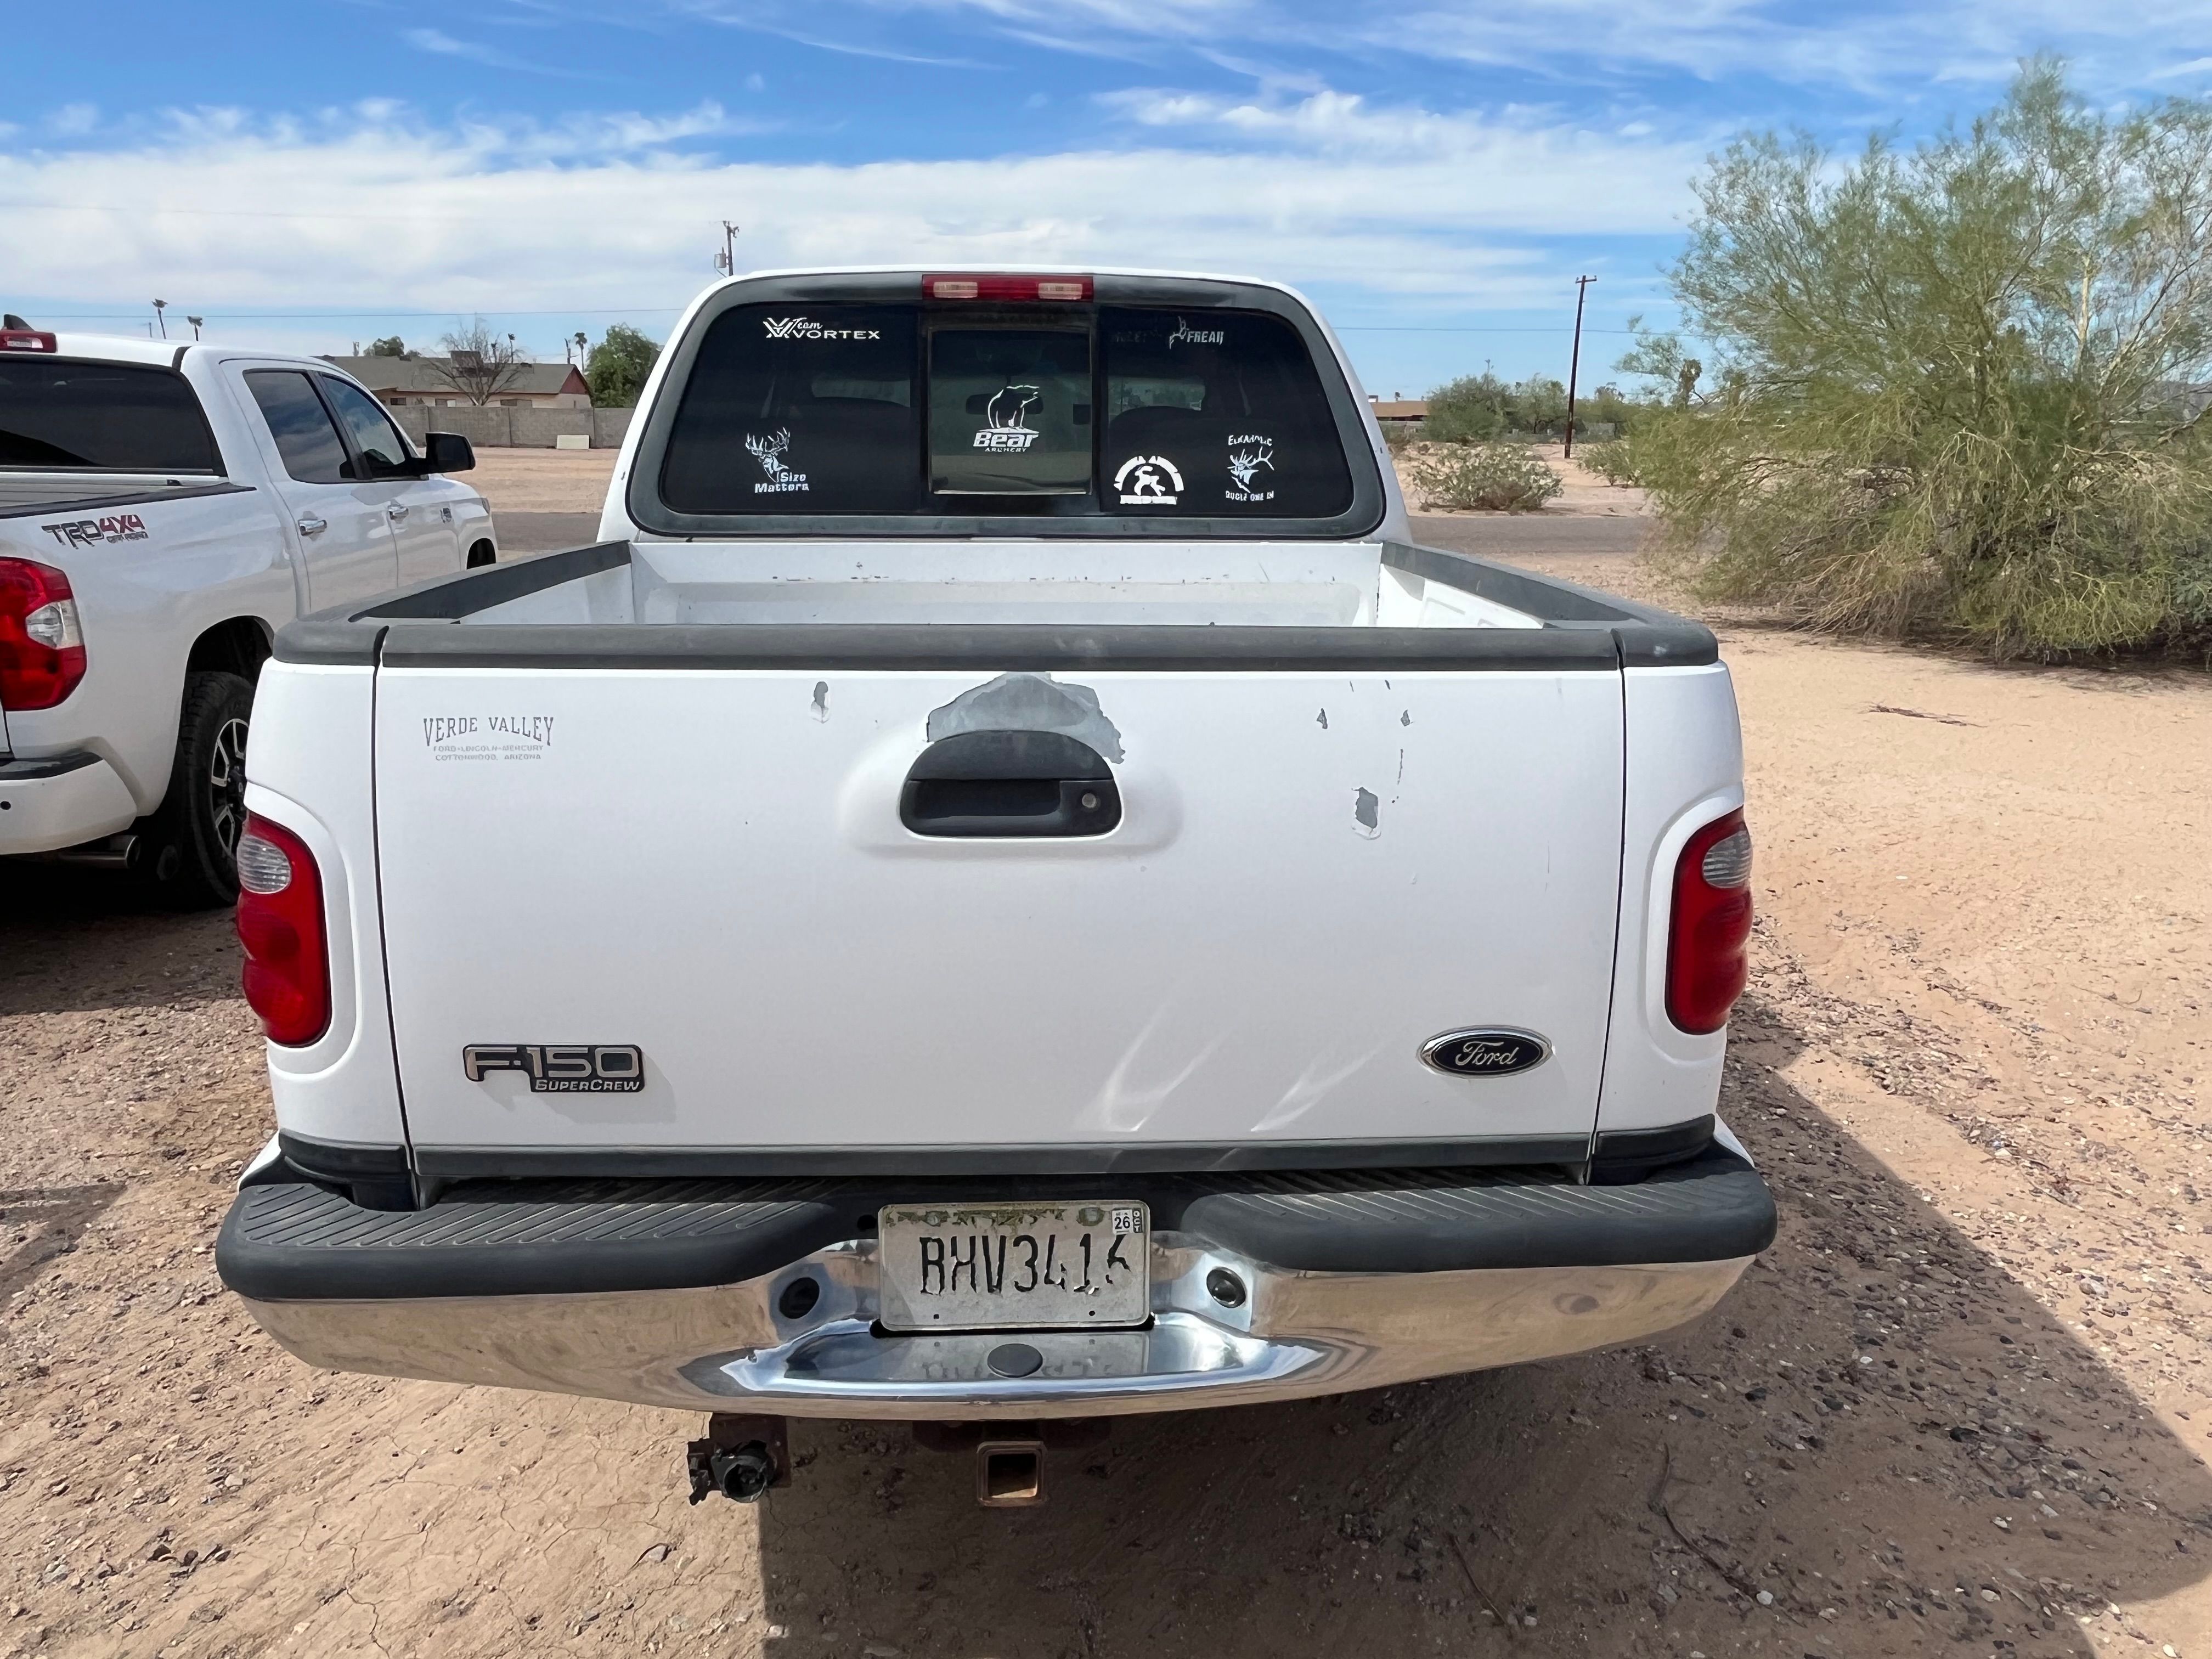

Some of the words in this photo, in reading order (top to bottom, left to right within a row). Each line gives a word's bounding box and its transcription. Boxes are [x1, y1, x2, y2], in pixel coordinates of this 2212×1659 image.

[790, 317, 823, 331] Team
[792, 330, 880, 339] VORTEX
[973, 432, 1039, 448] Bear
[41, 520, 105, 550] TRD
[423, 718, 478, 747] VERDE
[488, 716, 554, 747] VALLEY
[465, 1046, 640, 1081] F-150
[1455, 1041, 1519, 1066] Ford
[1114, 1216, 1130, 1229] 26
